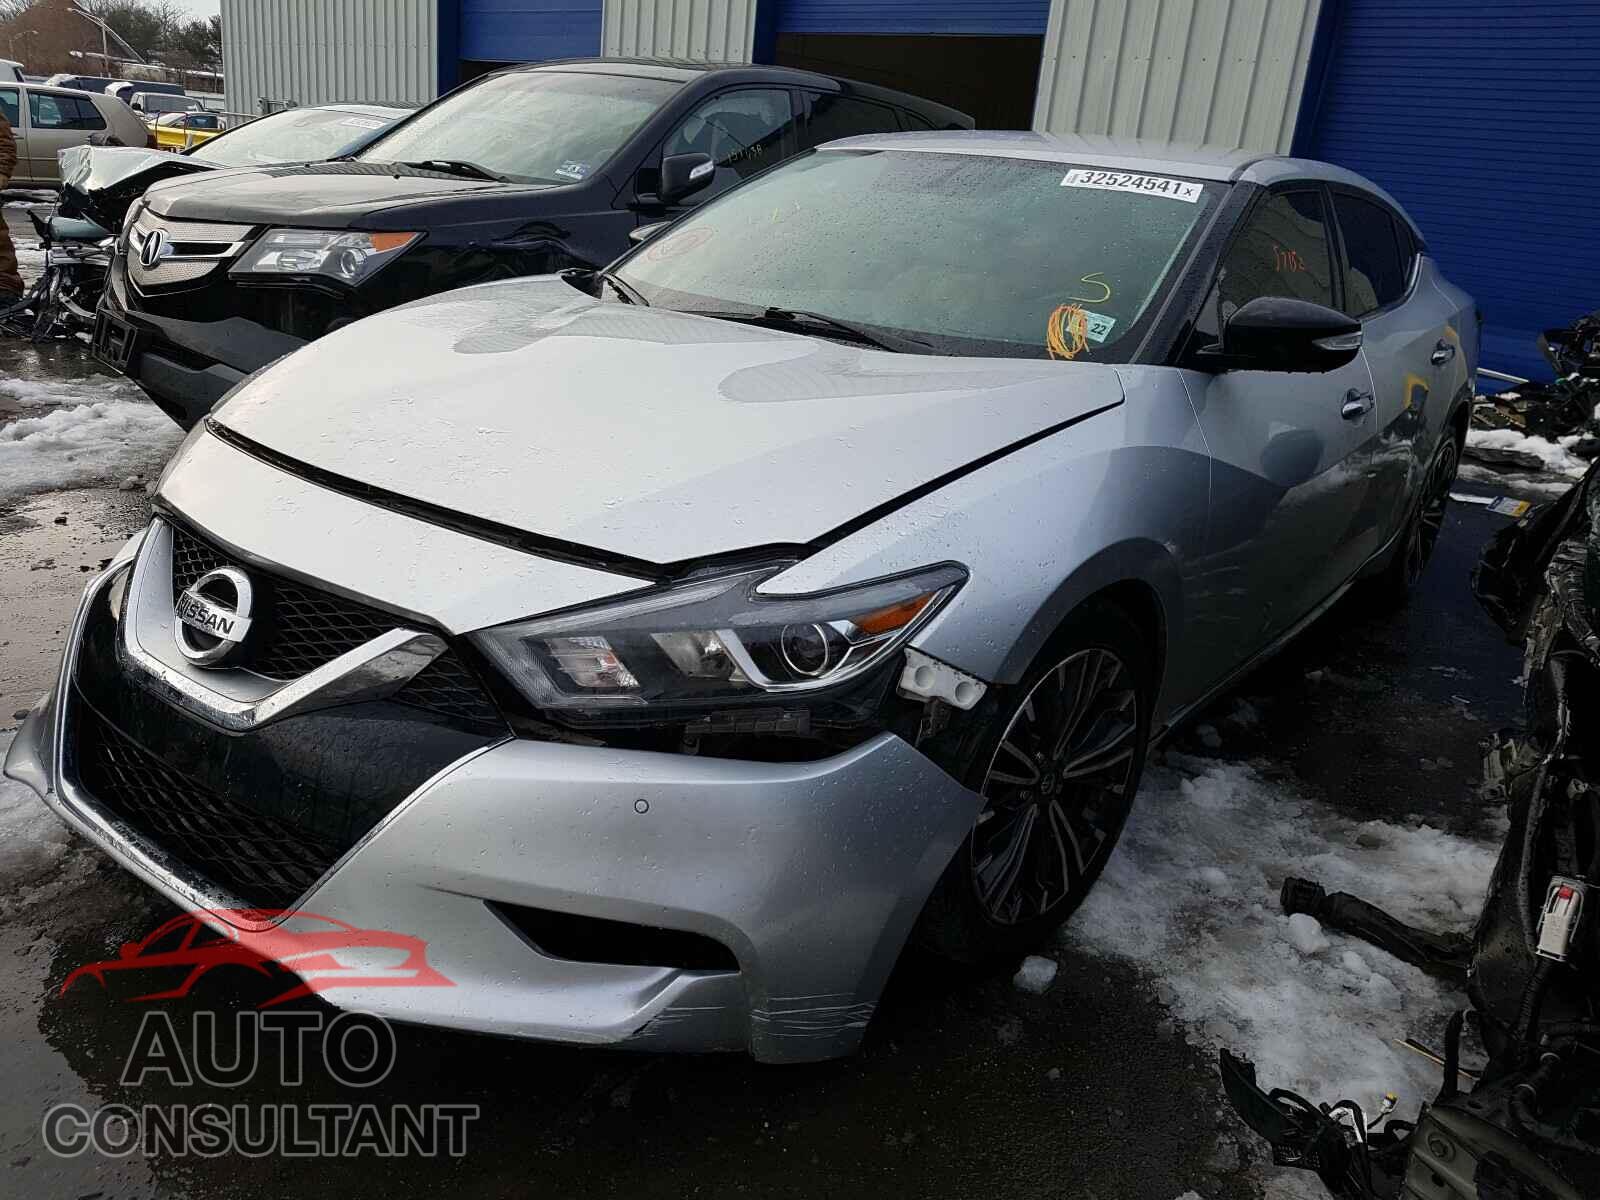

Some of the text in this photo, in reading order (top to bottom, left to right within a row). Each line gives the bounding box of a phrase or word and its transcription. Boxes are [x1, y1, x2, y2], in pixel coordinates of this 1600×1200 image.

[1080, 171, 1181, 195] 32524541
[1090, 323, 1107, 336] 22
[176, 594, 235, 635] NISSAN
